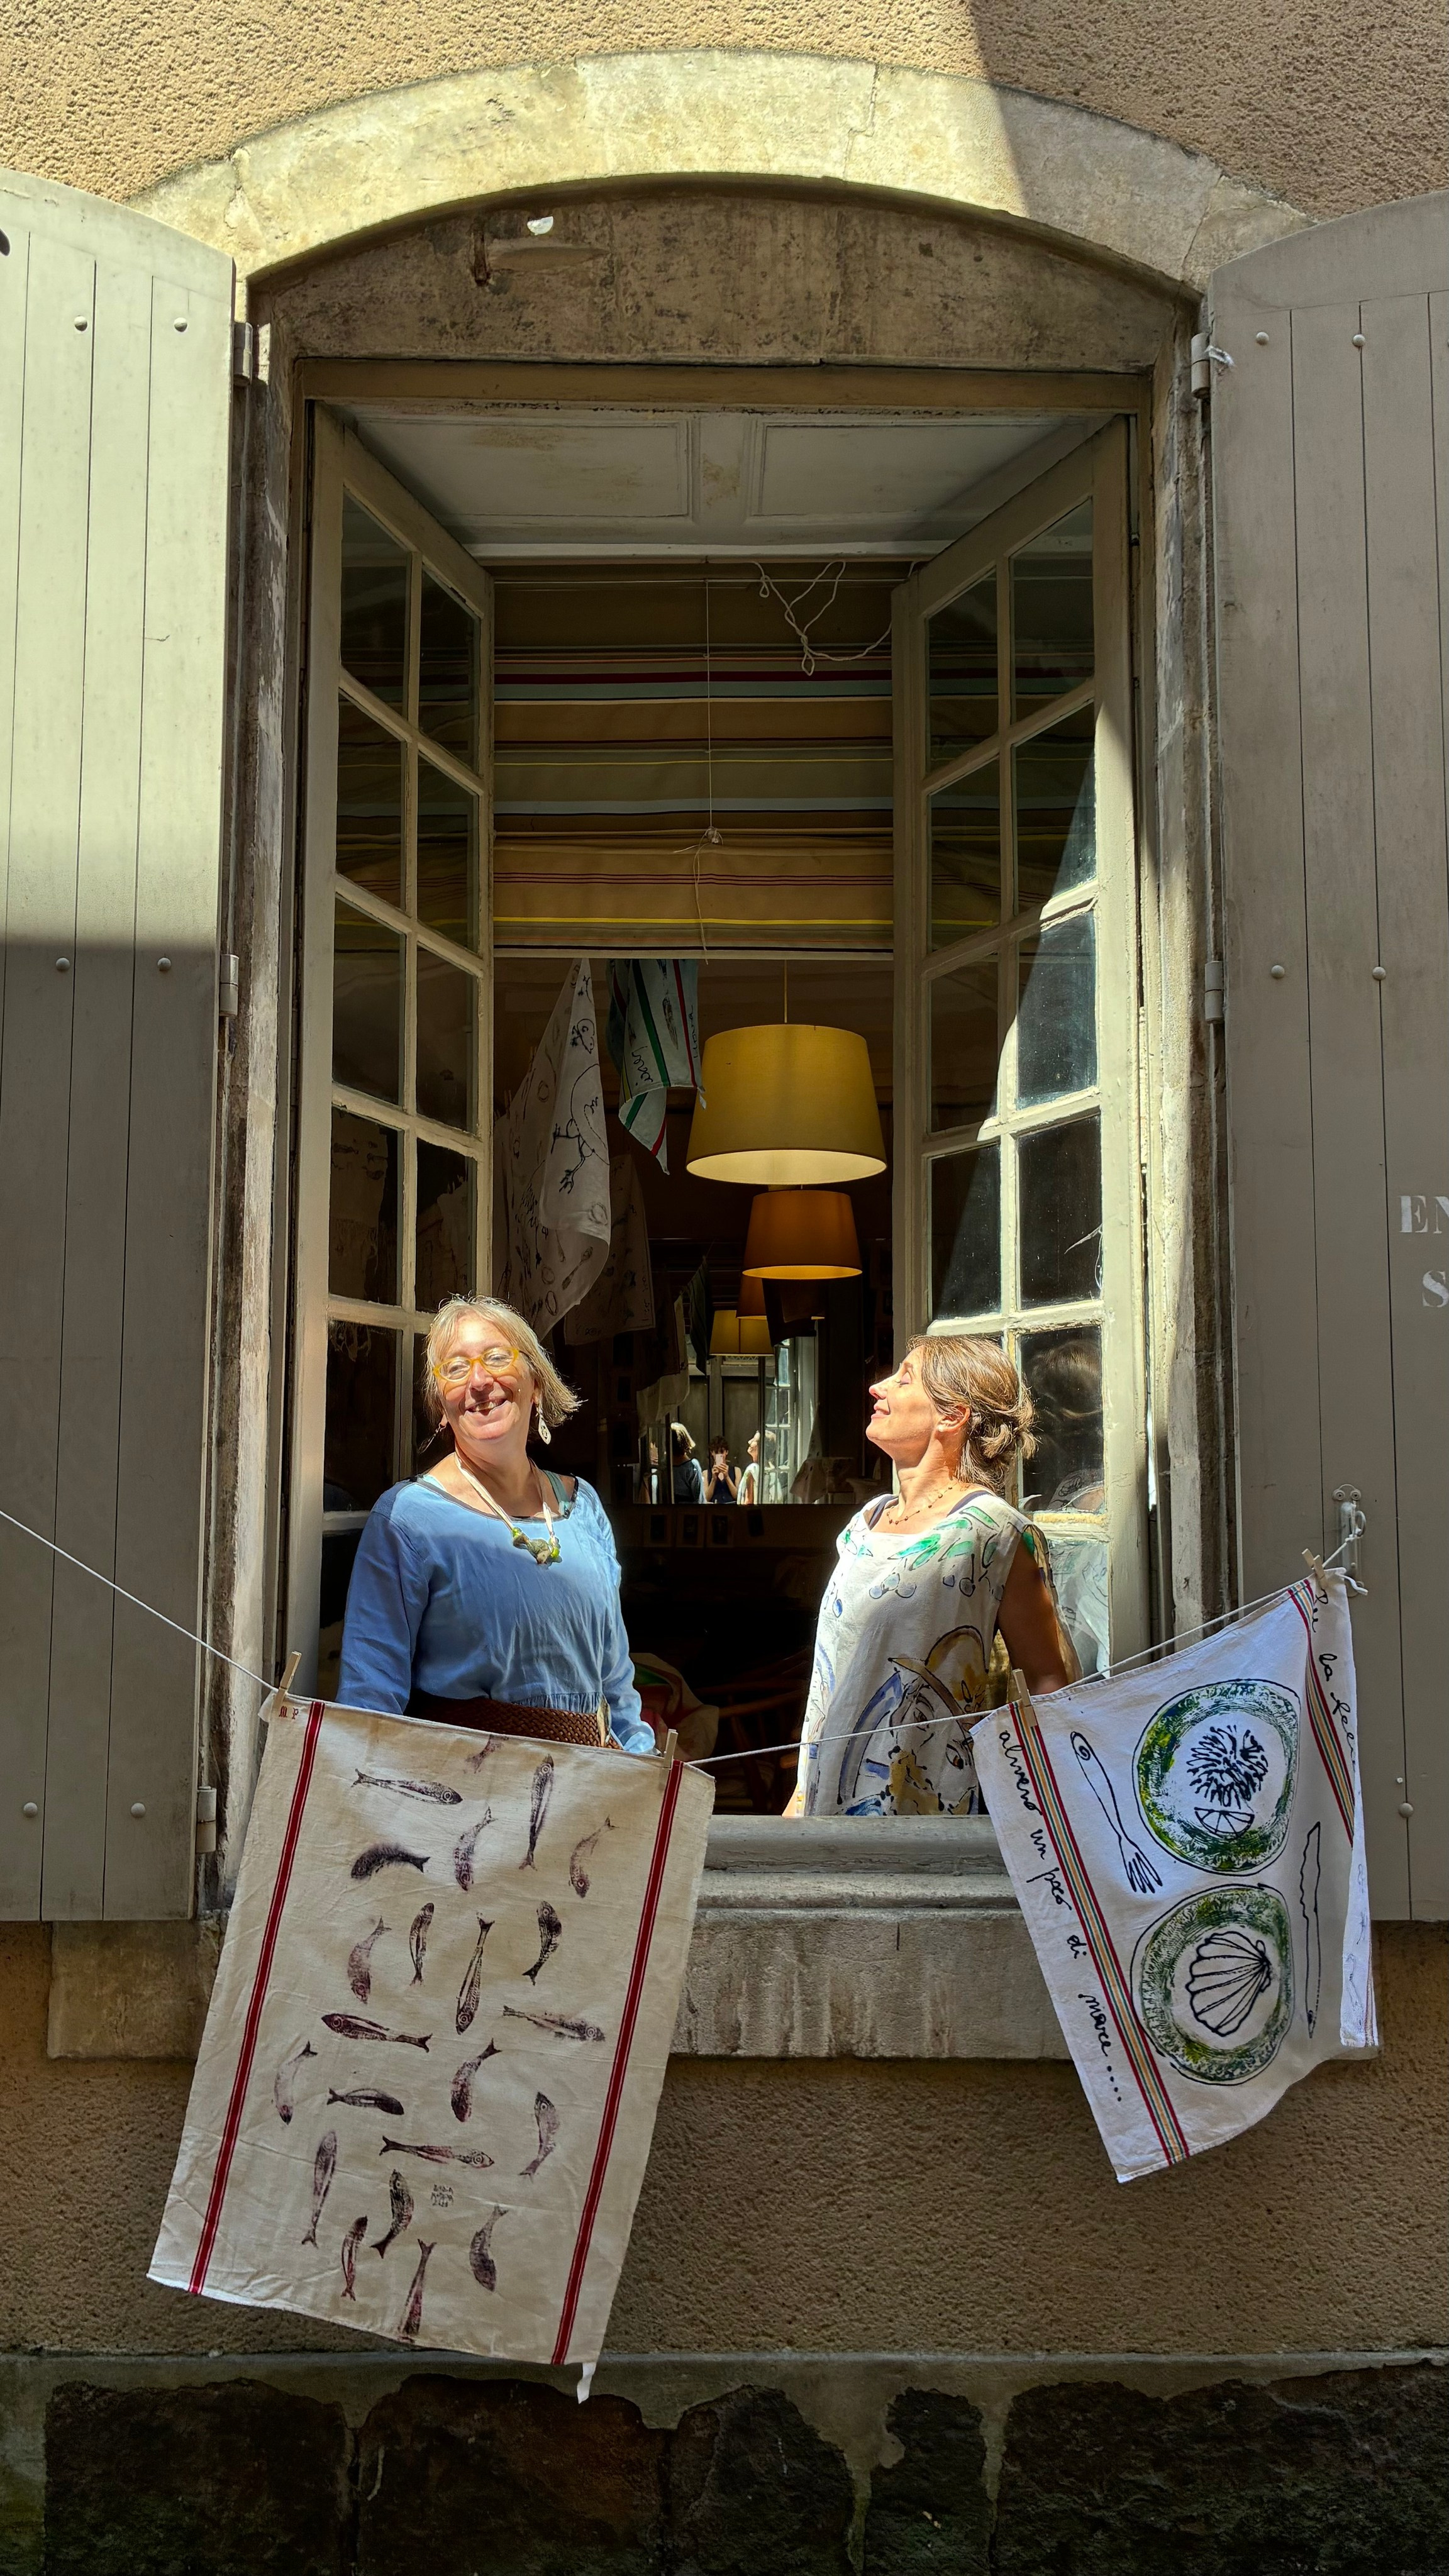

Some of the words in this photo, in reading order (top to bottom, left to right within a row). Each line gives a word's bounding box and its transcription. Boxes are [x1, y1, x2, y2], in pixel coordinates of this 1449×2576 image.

[1319, 1653, 1338, 1682] la
[999, 1729, 1044, 1816] almeno
[1030, 1828, 1046, 1861] un
[1026, 1866, 1072, 1911] poco
[1067, 1935, 1087, 1960] di
